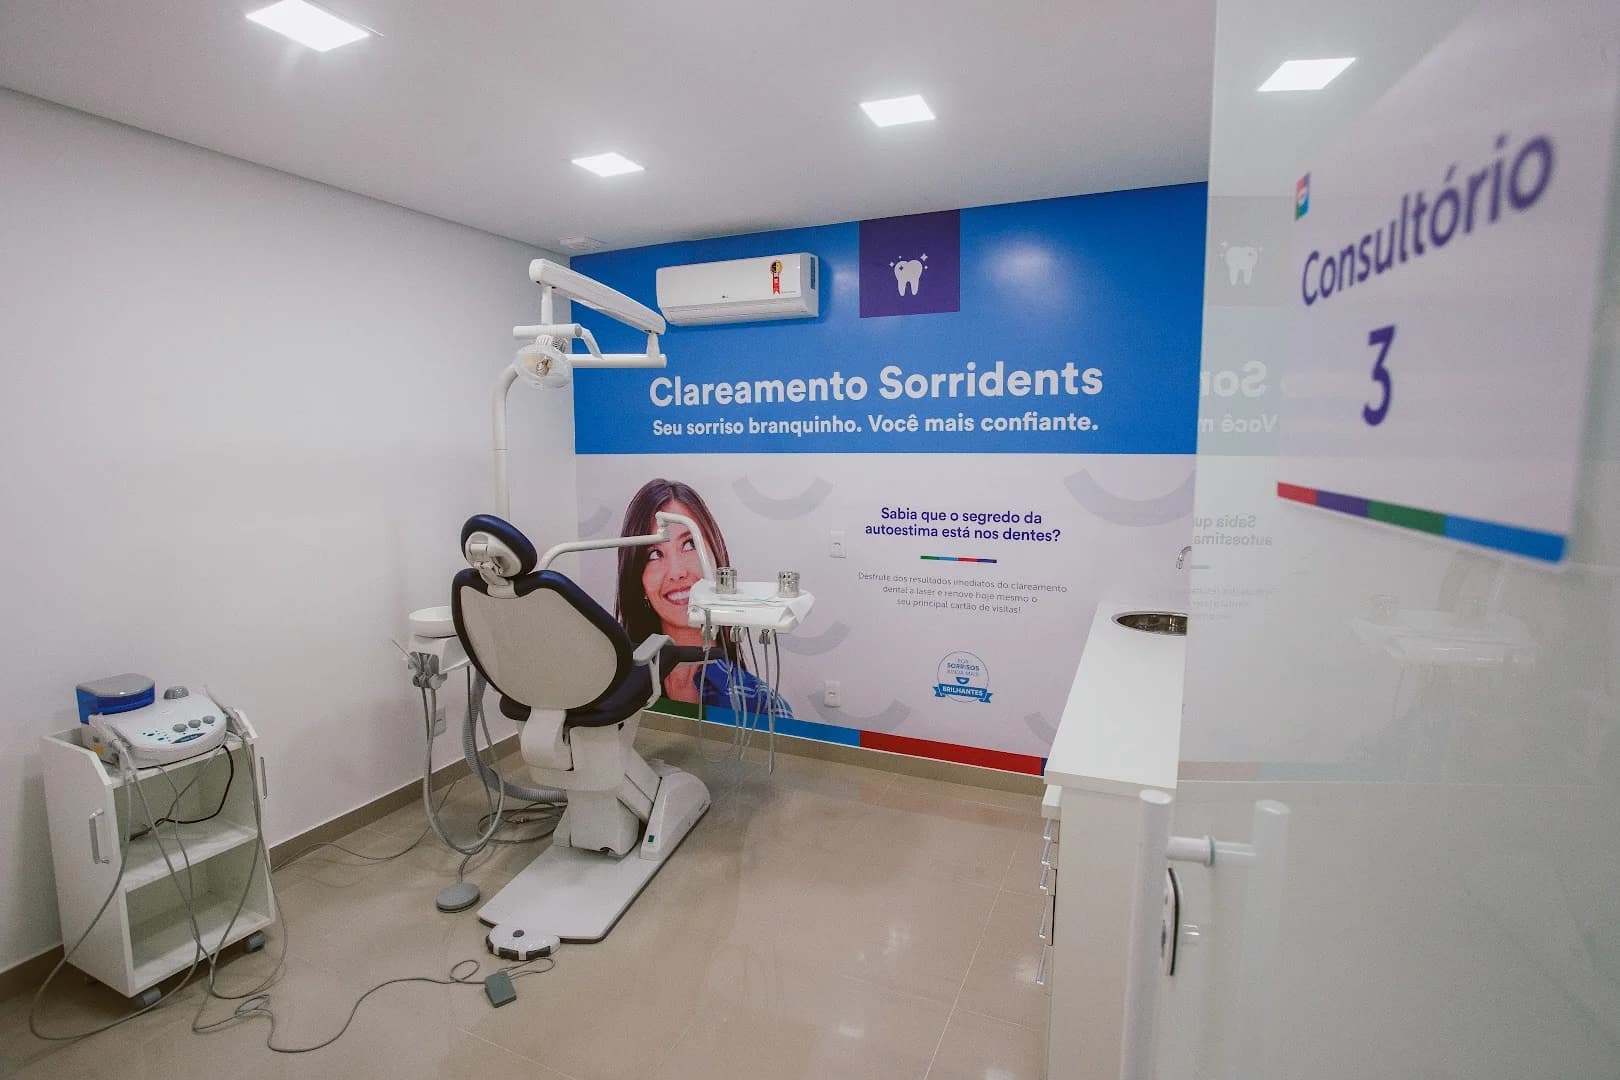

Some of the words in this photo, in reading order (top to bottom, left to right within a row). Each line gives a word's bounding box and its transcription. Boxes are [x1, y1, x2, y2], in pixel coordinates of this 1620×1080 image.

[1302, 132, 1556, 306] Consultório
[649, 371, 868, 406] Clareamento
[878, 361, 1104, 400] Sorridents
[1362, 324, 1396, 427] 3
[652, 419, 683, 436] Seu
[686, 418, 744, 435] sorriso
[748, 415, 862, 437] branquinho.
[868, 414, 919, 433] Você
[925, 412, 975, 432] mais
[980, 411, 1099, 432] confiante.
[881, 507, 917, 520] Sabia
[921, 510, 947, 523] que
[950, 511, 959, 521] o
[962, 511, 1020, 525] segredo
[1024, 511, 1042, 524] da
[865, 523, 938, 537] autoestima
[942, 526, 970, 538] está
[974, 529, 999, 540] nos
[1002, 528, 1061, 542] dentes?
[858, 572, 891, 582] Desfrute
[909, 575, 952, 586] resultados
[997, 580, 1009, 589] do
[1010, 581, 1067, 593] clareamento
[882, 585, 908, 594] dental
[944, 590, 974, 599] renove
[975, 590, 995, 601] hoje
[996, 593, 1028, 603] mesmo
[897, 598, 911, 606] seu
[913, 598, 948, 609] principal
[950, 601, 977, 611] cartão
[979, 603, 990, 612] de
[992, 605, 1021, 614] visitas!
[942, 686, 982, 696] BRILHANTES
